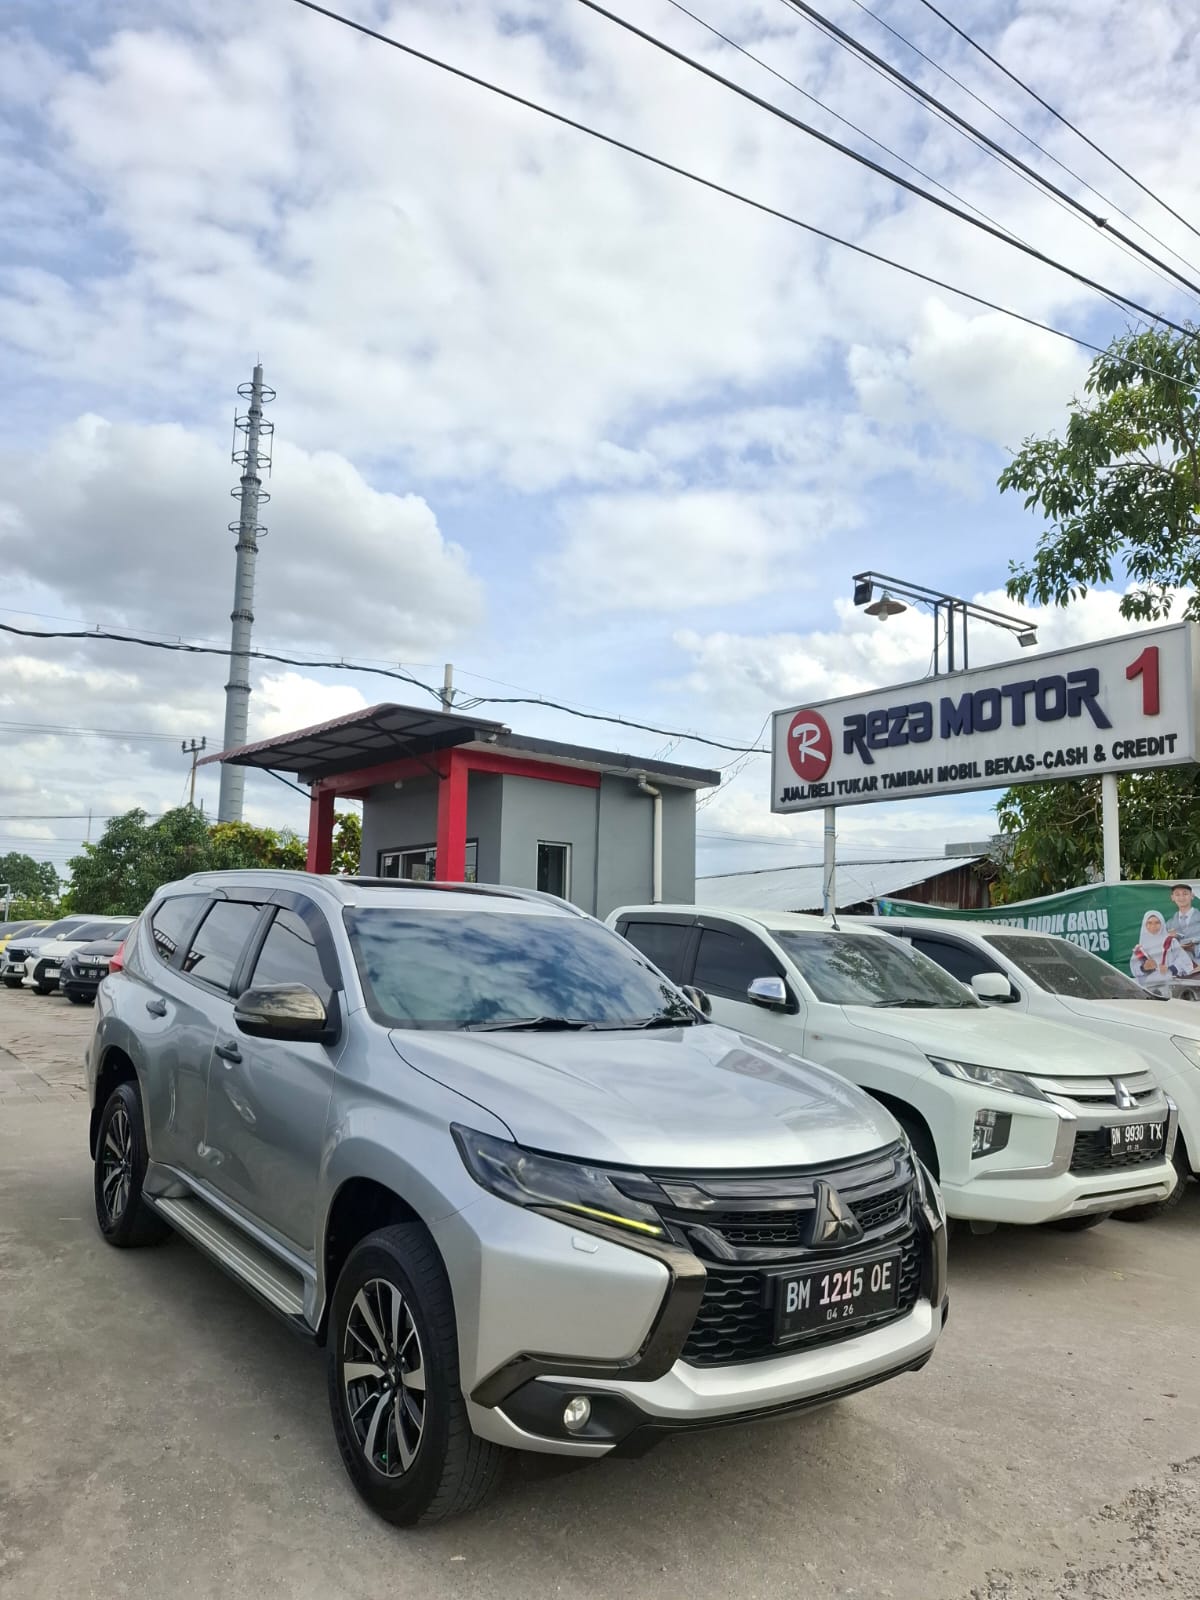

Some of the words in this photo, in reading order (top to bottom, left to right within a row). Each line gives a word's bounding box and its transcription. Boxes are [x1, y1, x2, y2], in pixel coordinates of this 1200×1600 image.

[940, 667, 1113, 739] MOTOR
[1126, 646, 1160, 716] 1
[792, 723, 826, 763] R
[780, 781, 836, 803] JUAL/BELI
[836, 776, 878, 796] TUKAR
[881, 768, 933, 790] TAMBAH
[937, 761, 981, 782] MOBIL
[1093, 744, 1106, 763] &
[1112, 733, 1177, 760] CREDIT
[1028, 913, 1066, 932] DIDIK
[1067, 909, 1109, 931] BARU
[1125, 1125, 1144, 1143] 9930
[1150, 1124, 1162, 1140] TX
[786, 1279, 811, 1312] BM
[820, 1268, 864, 1305] 1215
[871, 1261, 892, 1293] OE
[826, 1308, 838, 1320] 04
[842, 1304, 854, 1317] 26
